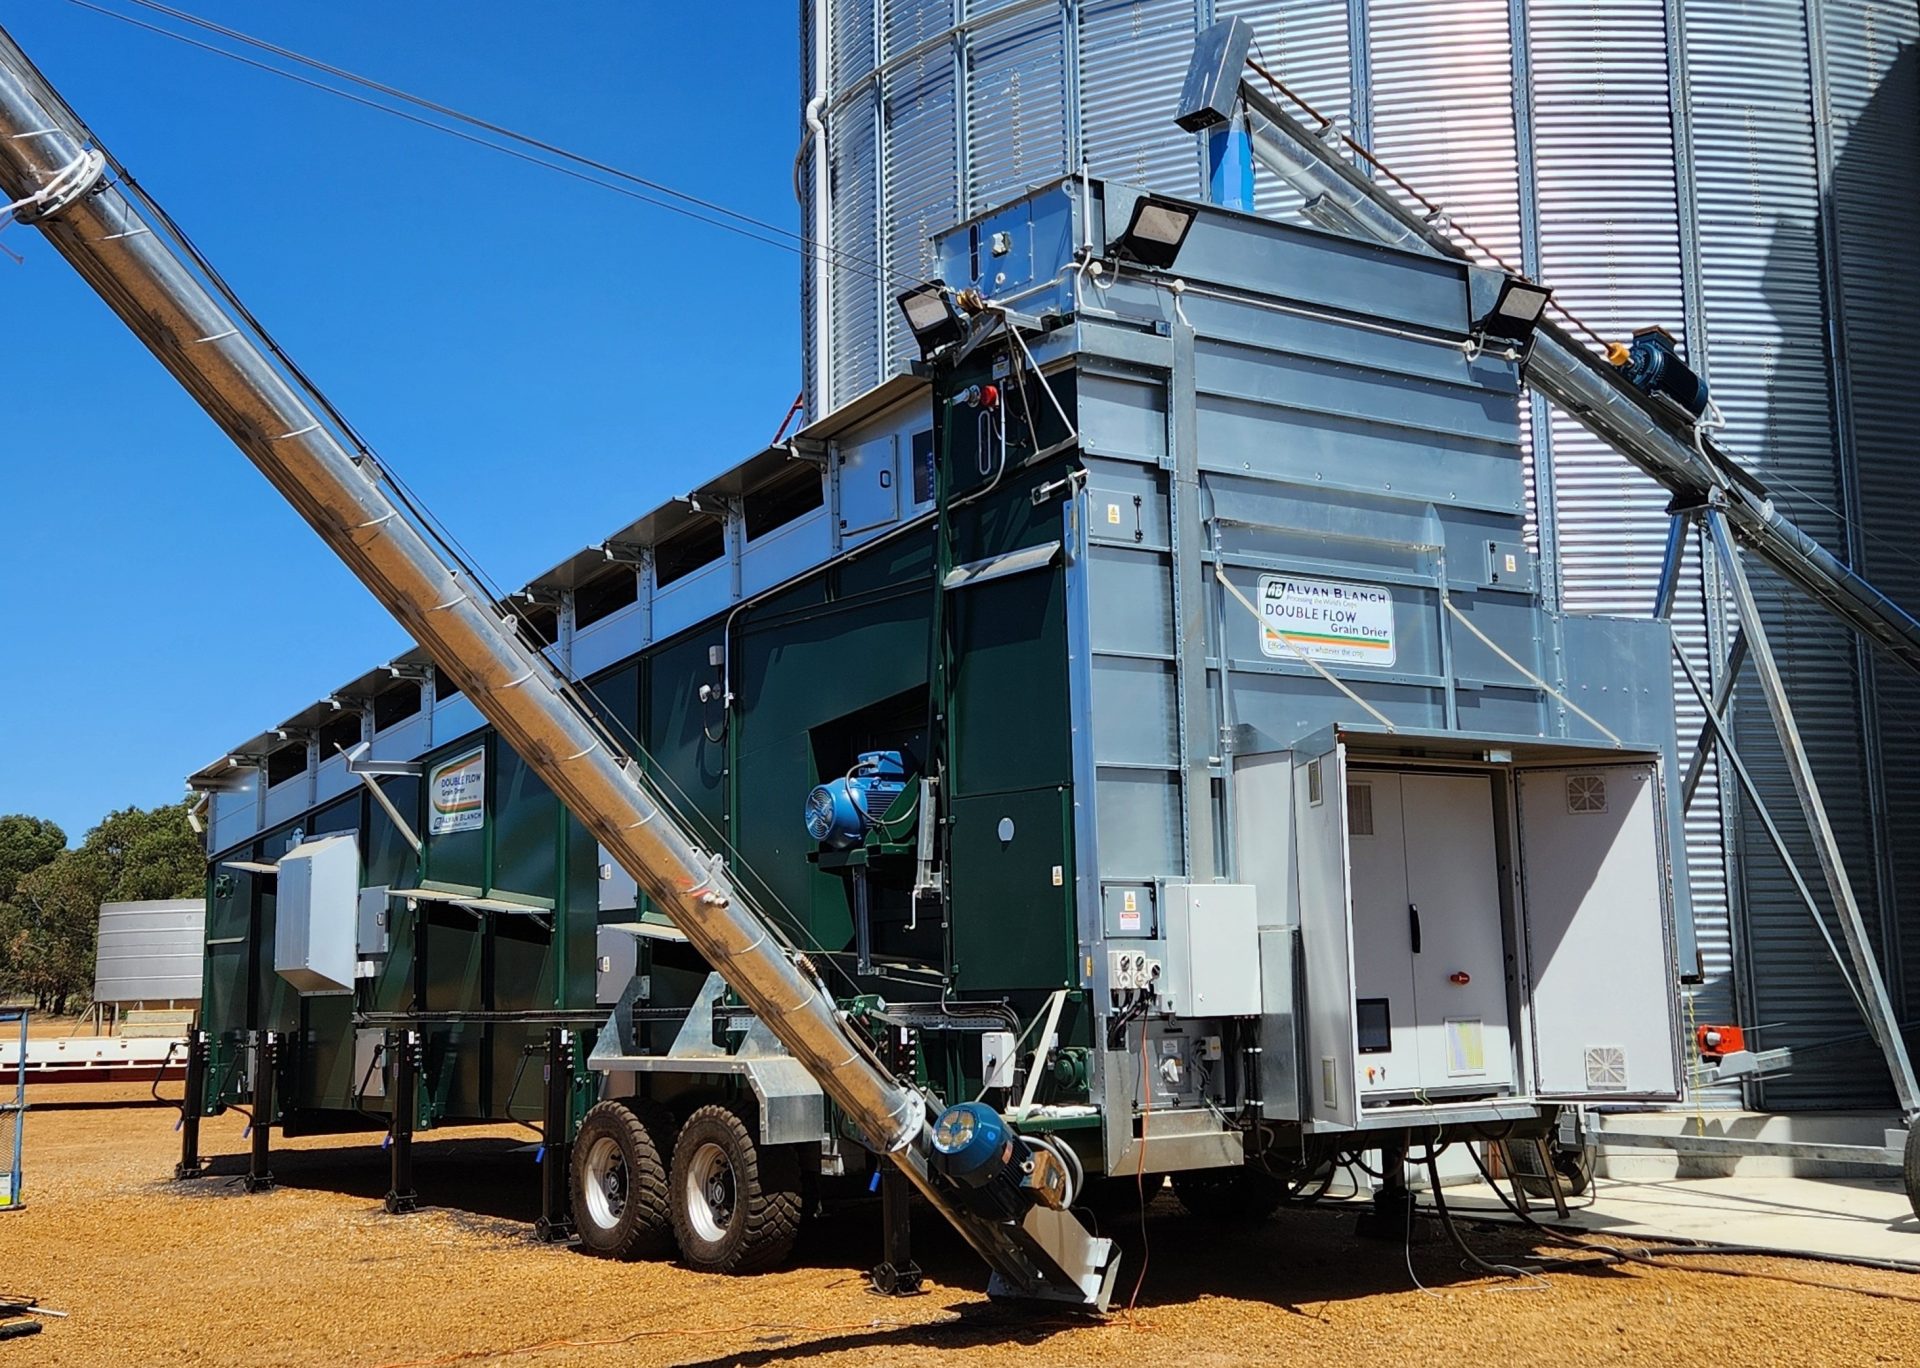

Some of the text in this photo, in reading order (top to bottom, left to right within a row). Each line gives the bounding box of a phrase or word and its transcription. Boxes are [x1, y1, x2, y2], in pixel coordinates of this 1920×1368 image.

[1287, 583, 1329, 597] ALVAN
[1334, 588, 1386, 603] BLANCH
[1265, 603, 1357, 623] DOUBLE FLOW
[1330, 623, 1388, 637] Grain Drier
[441, 774, 481, 787] DOUBLE FLOW
[460, 812, 482, 821] BLANCH
